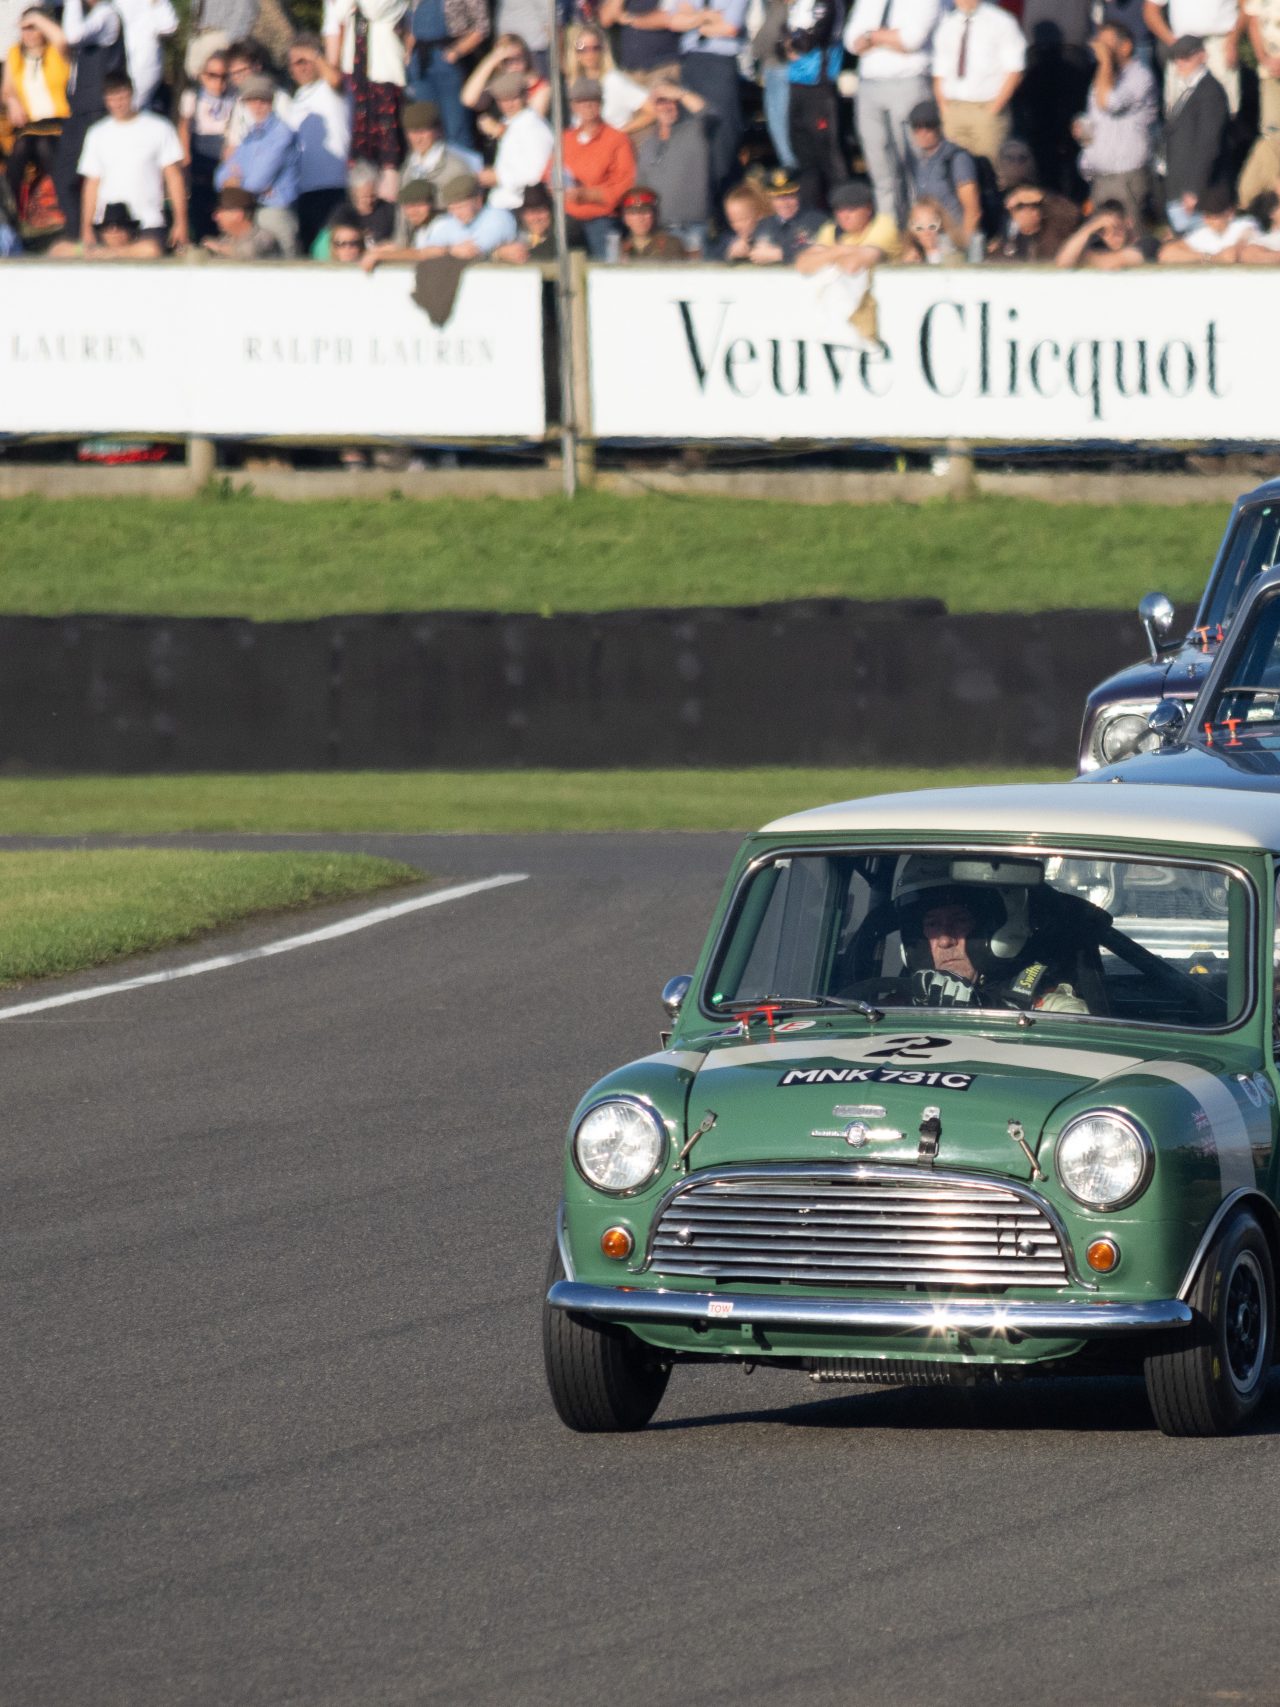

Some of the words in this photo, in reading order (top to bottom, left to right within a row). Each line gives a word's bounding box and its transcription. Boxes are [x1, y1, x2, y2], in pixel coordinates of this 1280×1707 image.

[11, 334, 145, 362] LAUREN
[243, 335, 353, 363] RALPH
[369, 336, 494, 365] LAUREN
[671, 298, 893, 398] Veuve
[917, 298, 1230, 421] Clicquot
[863, 1036, 952, 1058] 2
[783, 1069, 875, 1084] MNK
[879, 1069, 970, 1088] 731C
[710, 1304, 731, 1313] TOW
